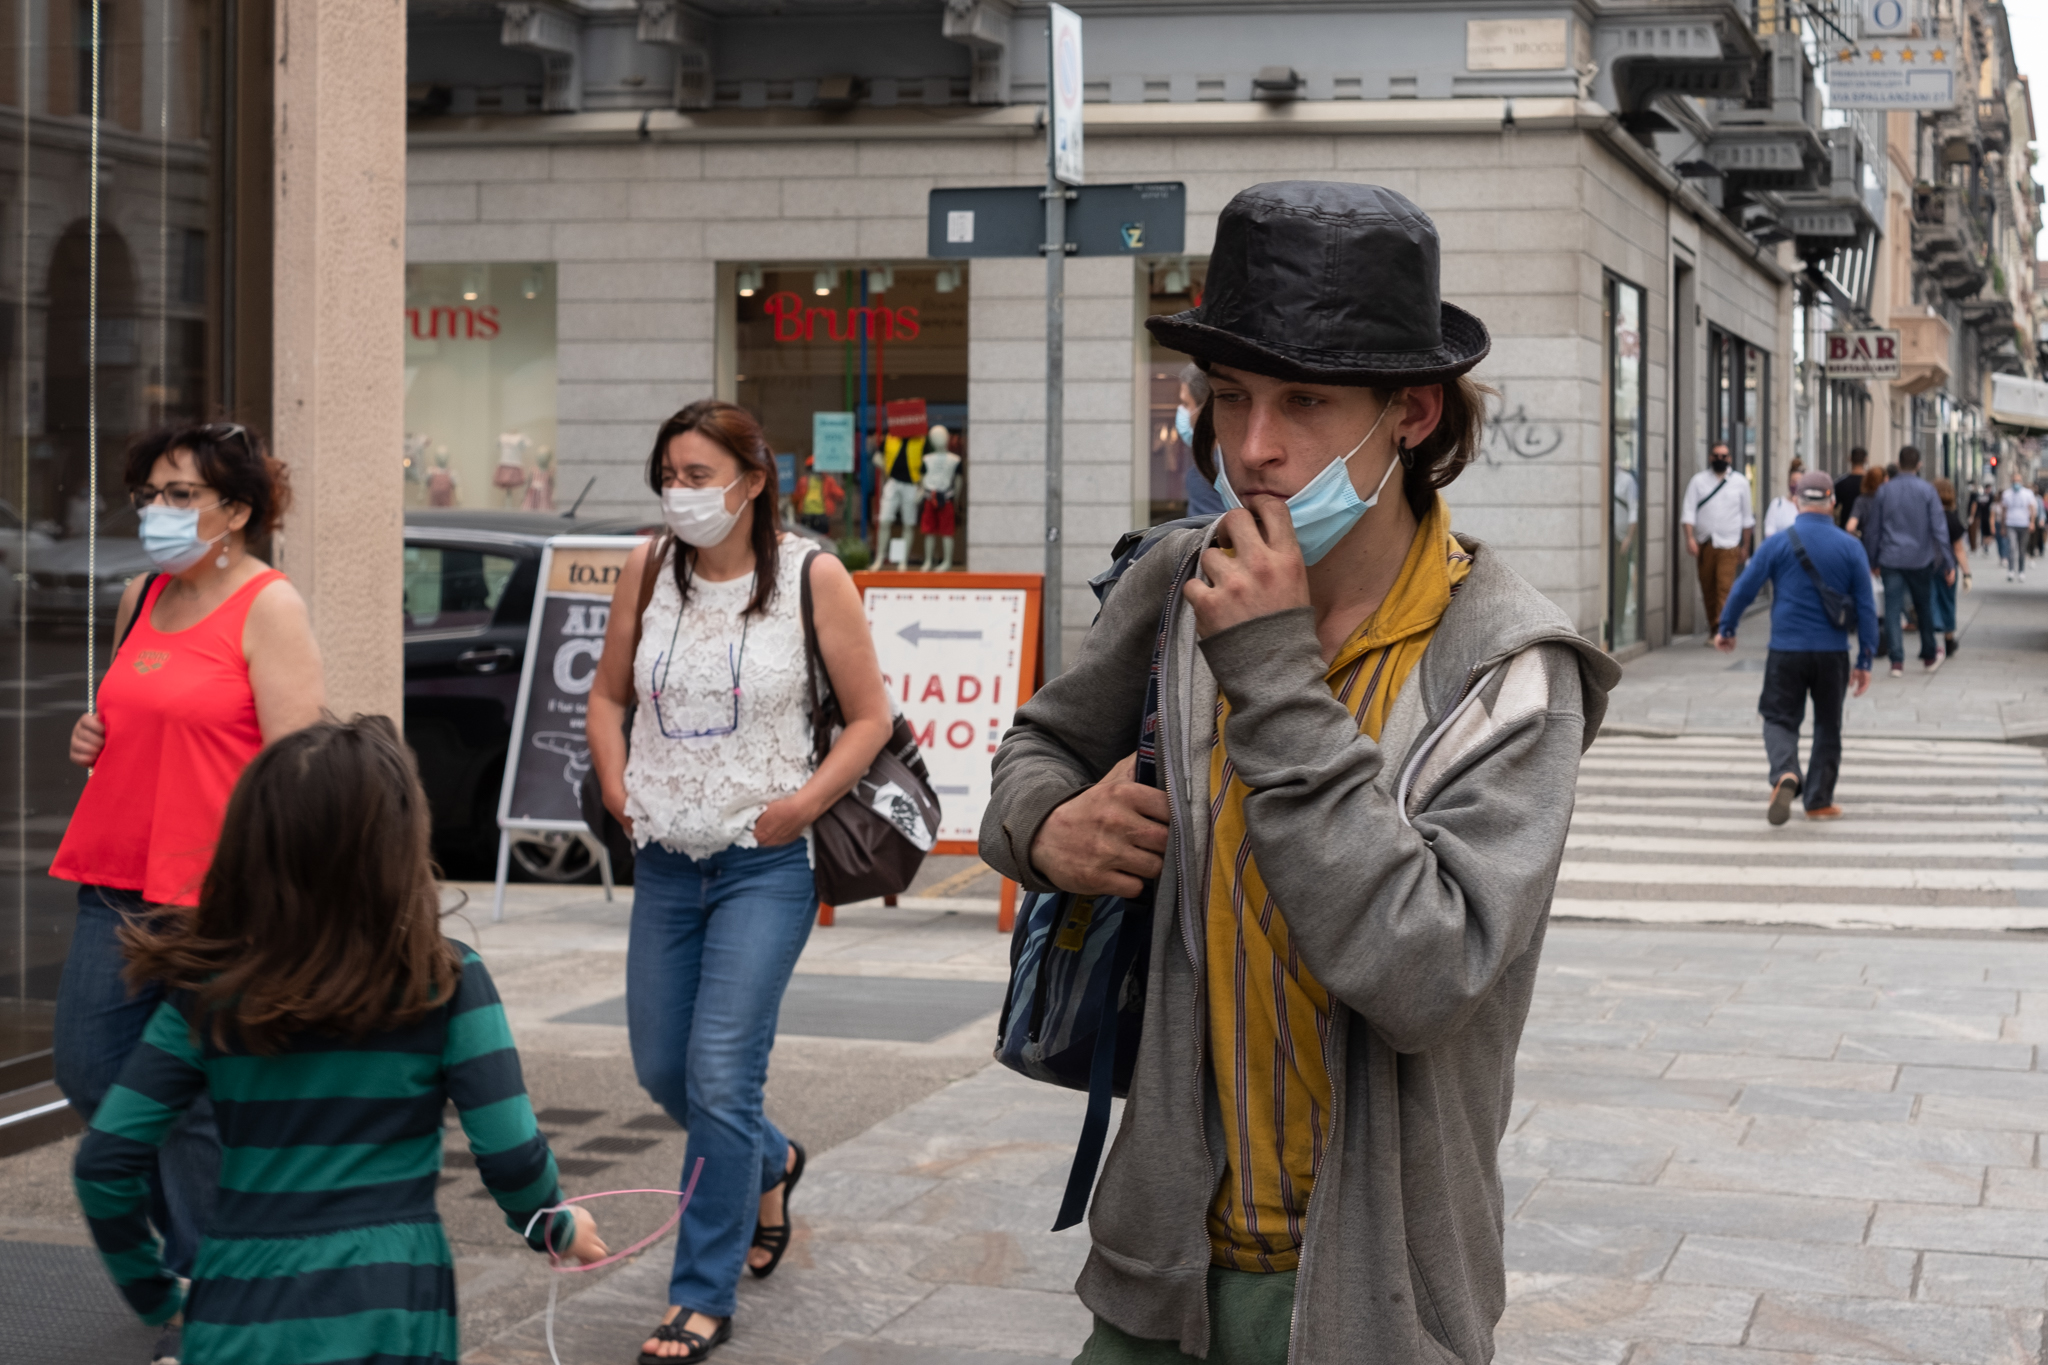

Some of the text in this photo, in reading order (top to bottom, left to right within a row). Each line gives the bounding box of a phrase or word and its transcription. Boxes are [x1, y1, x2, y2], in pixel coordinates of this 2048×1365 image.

[1831, 91, 1850, 103] VIA
[405, 304, 501, 340] ums
[764, 291, 920, 341] Brums
[1829, 336, 1895, 359] BAR
[882, 674, 1001, 704] IADI
